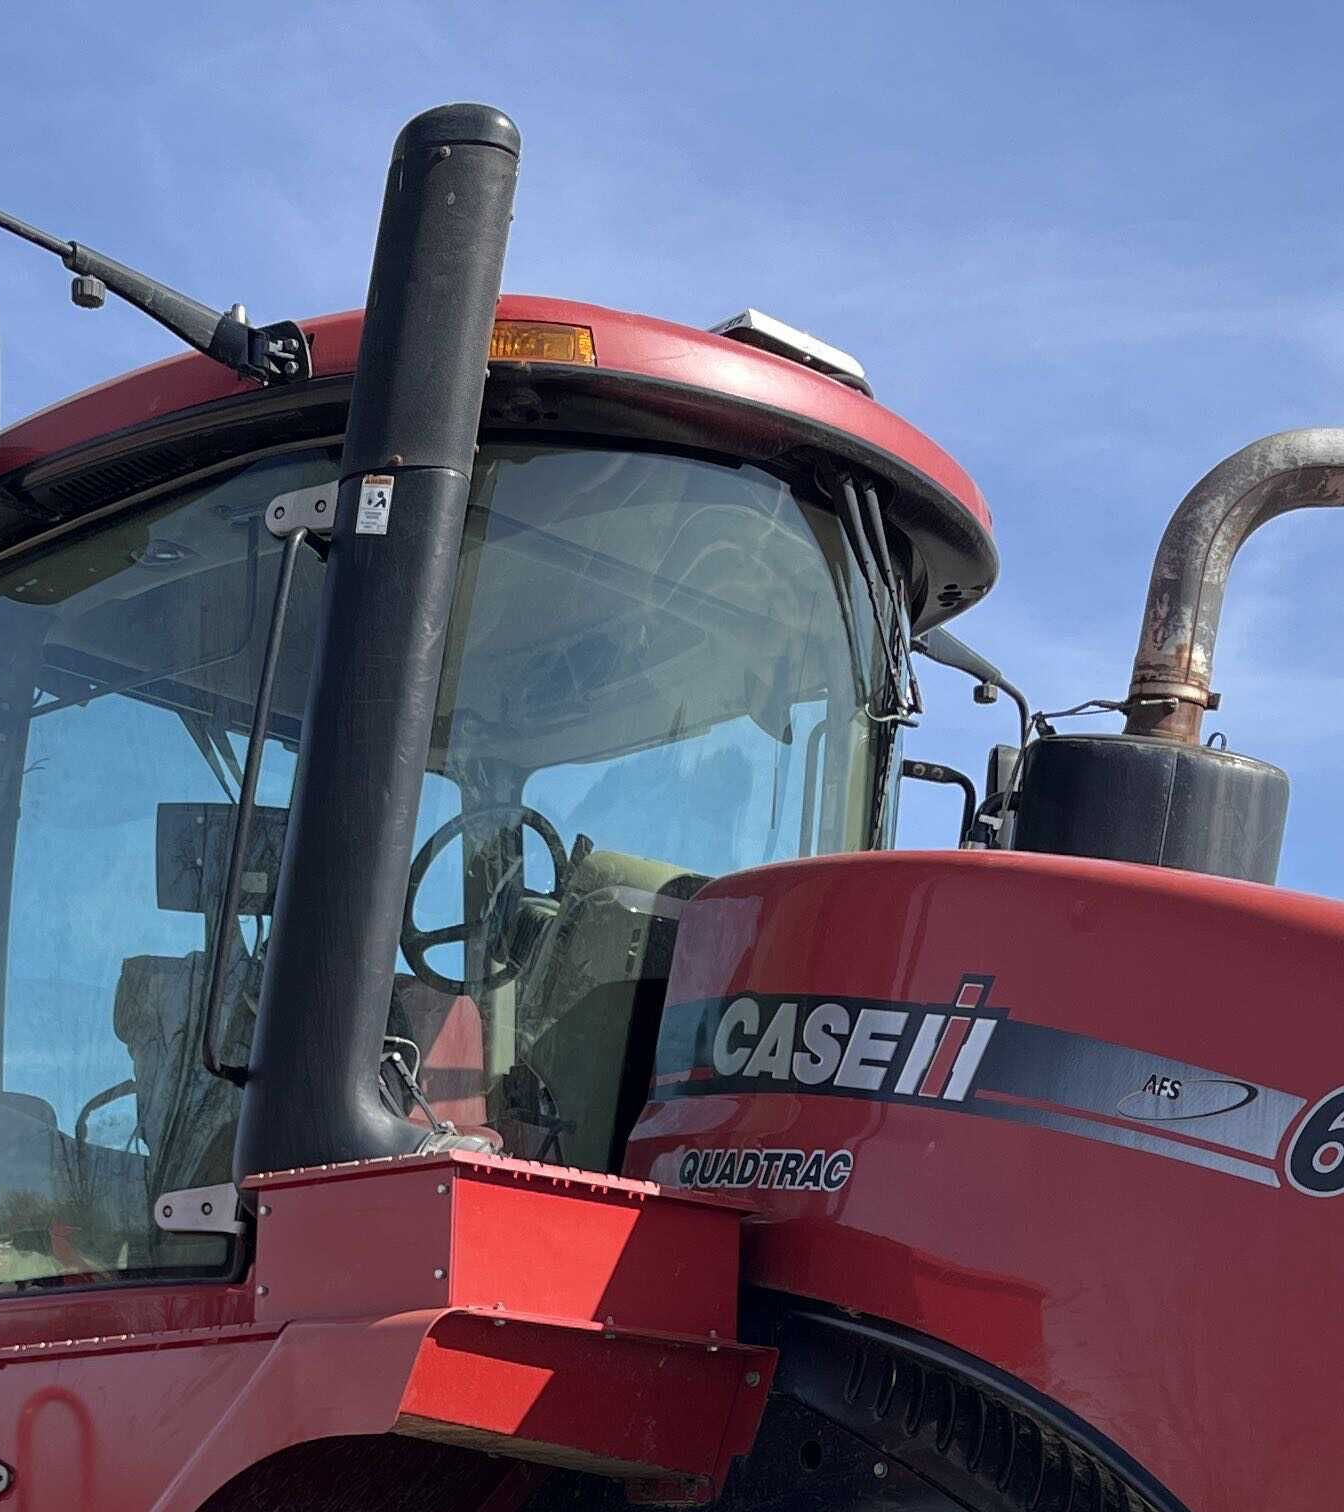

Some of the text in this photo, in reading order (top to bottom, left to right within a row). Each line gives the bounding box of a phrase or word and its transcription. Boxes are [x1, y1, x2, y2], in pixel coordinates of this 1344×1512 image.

[712, 997, 910, 1091] CASE
[1142, 1074, 1183, 1100] AFS
[678, 1149, 854, 1192] QUADTRAC
